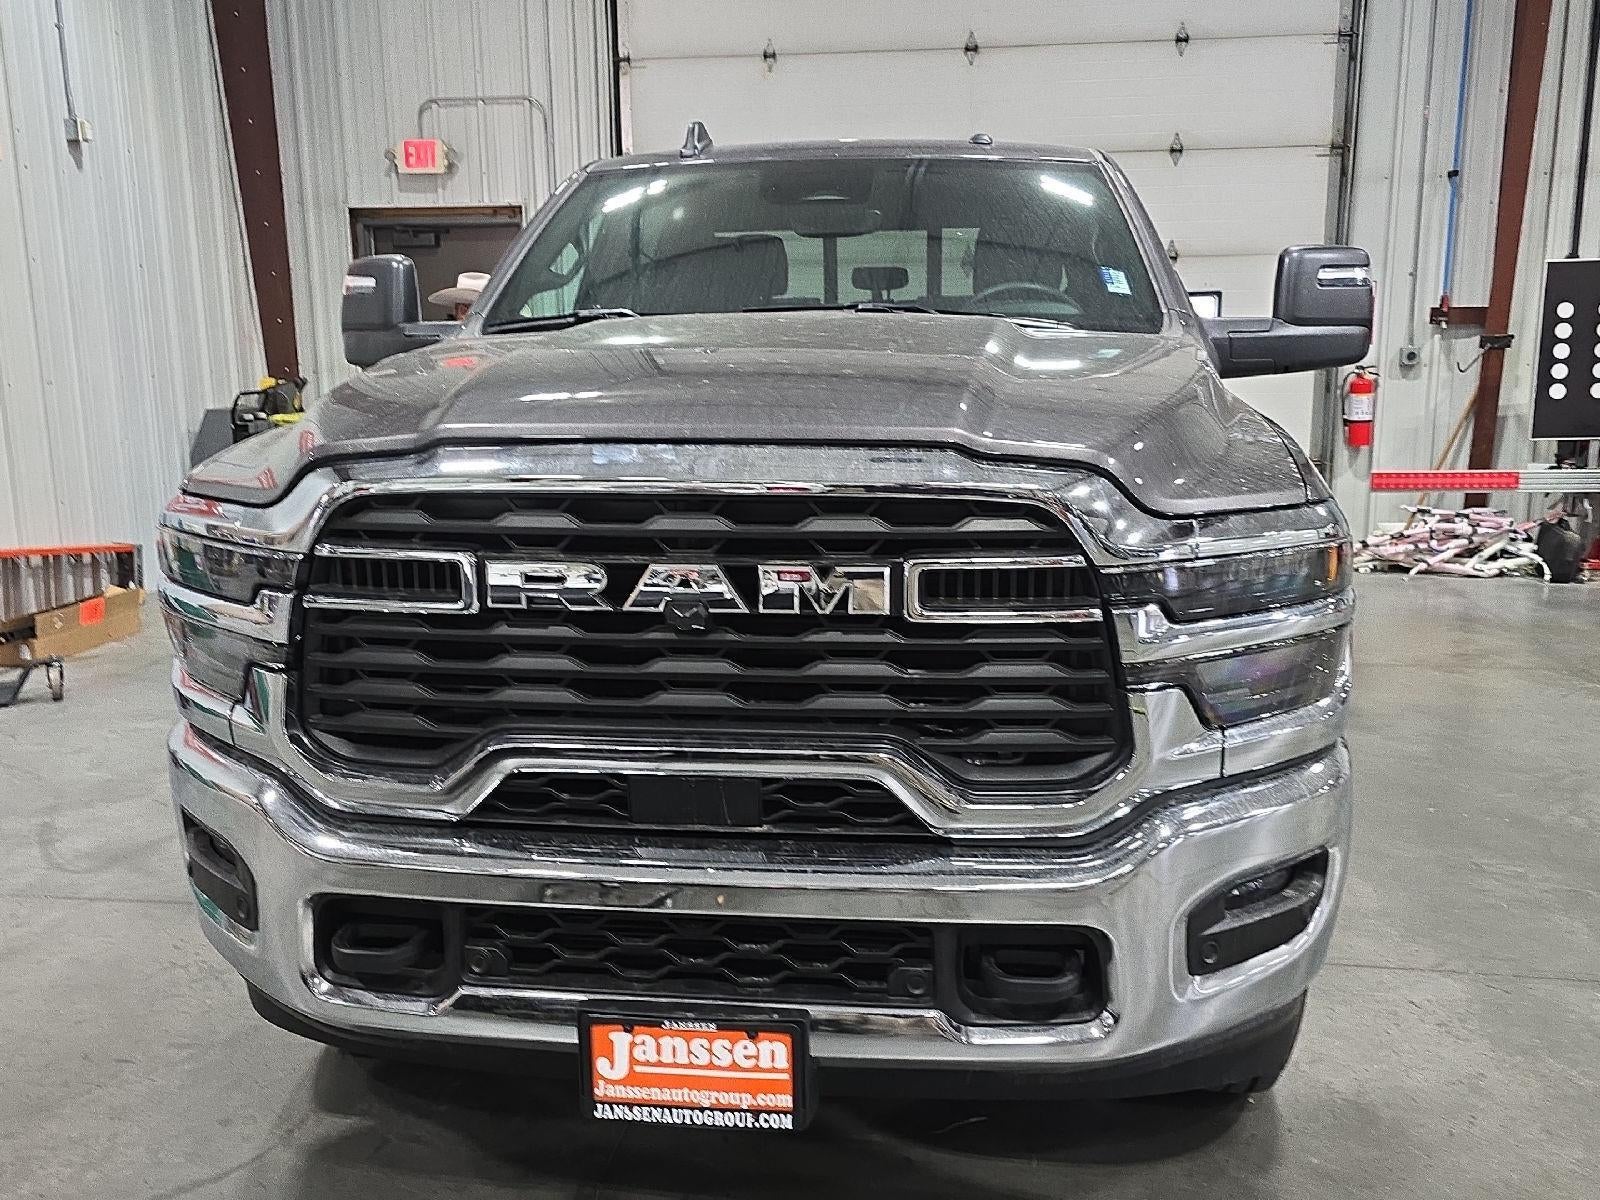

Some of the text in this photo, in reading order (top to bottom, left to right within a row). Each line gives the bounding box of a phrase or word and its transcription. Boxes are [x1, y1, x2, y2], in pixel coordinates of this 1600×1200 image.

[486, 561, 892, 615] RAM
[595, 1031, 790, 1081] Janssen
[594, 1080, 793, 1110] Janssenautogroup.com
[594, 1103, 793, 1130] JANSSENAUTOGROUP.COM
